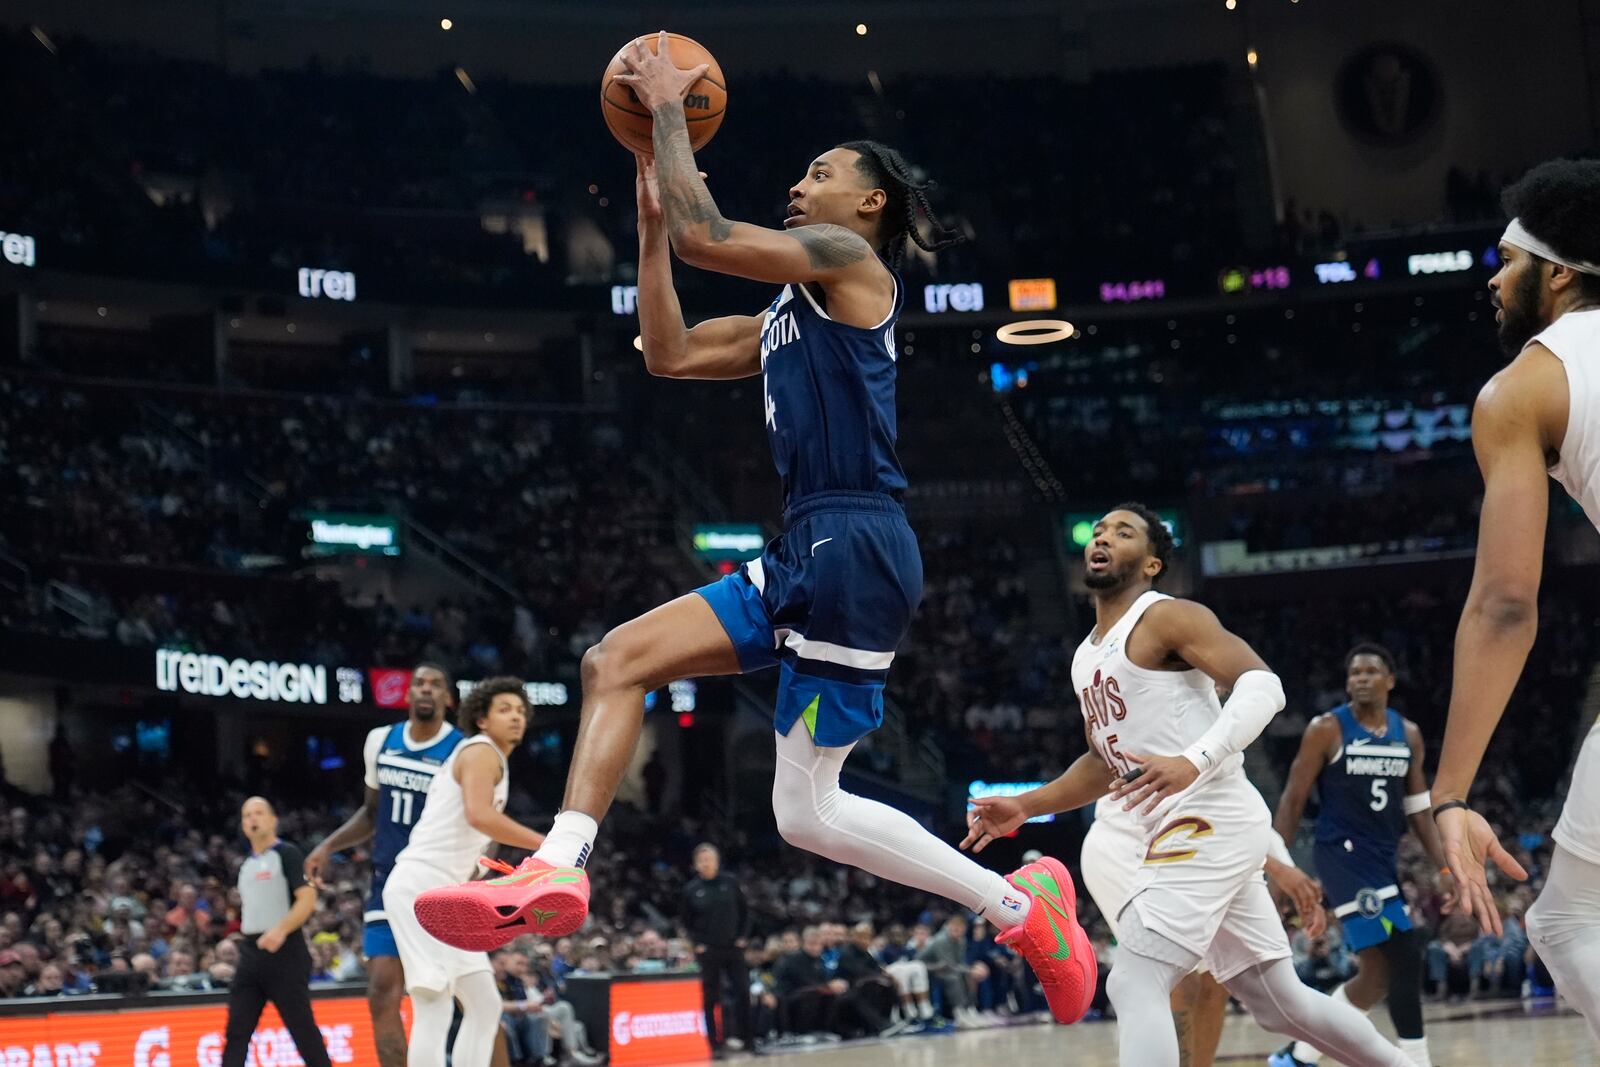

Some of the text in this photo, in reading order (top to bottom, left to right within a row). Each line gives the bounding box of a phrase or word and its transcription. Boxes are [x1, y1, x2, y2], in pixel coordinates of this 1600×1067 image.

[1408, 250, 1473, 275] FOULS
[390, 790, 414, 825] 11
[1369, 778, 1388, 812] 5
